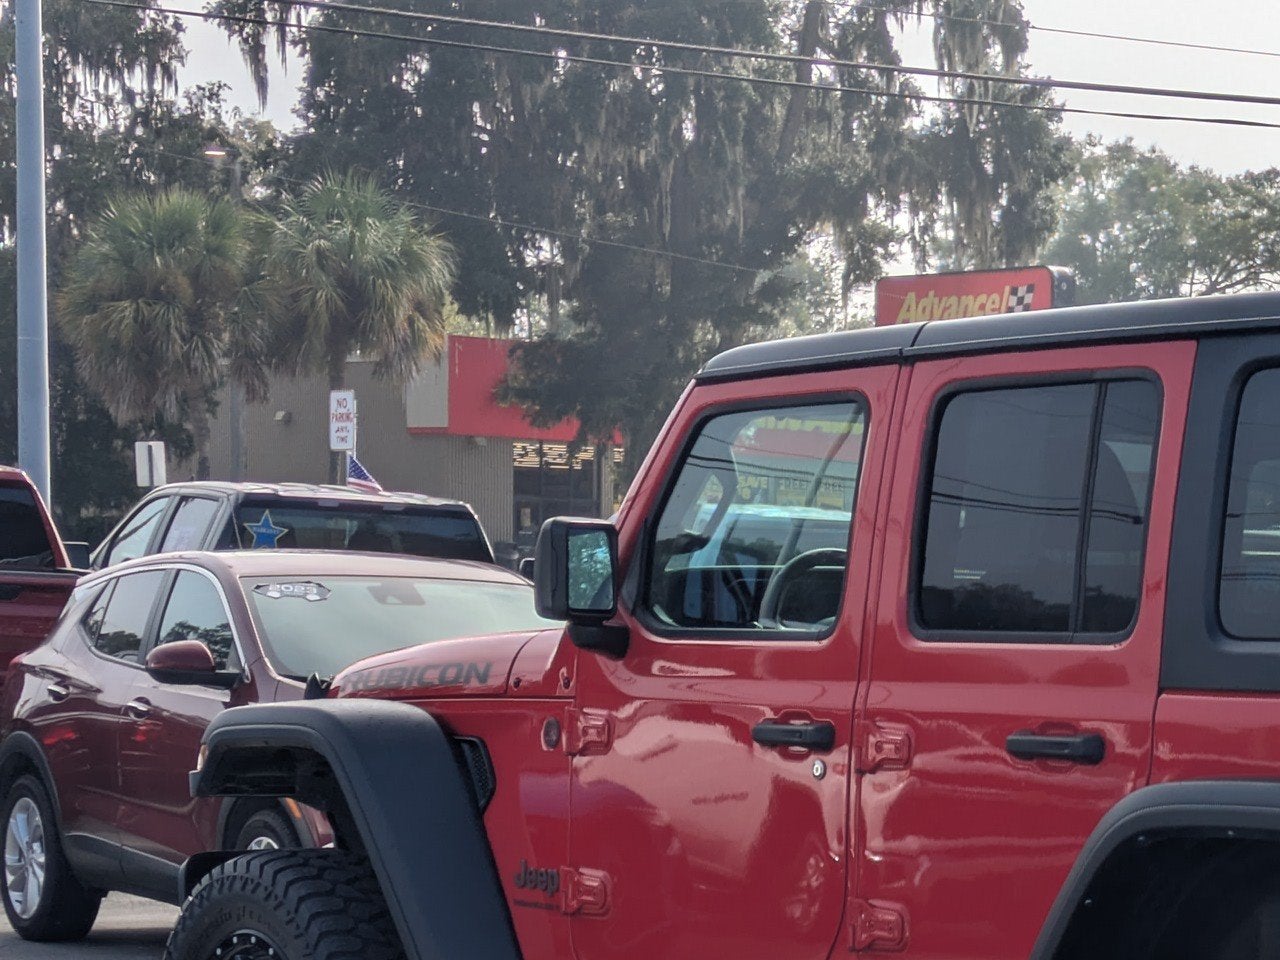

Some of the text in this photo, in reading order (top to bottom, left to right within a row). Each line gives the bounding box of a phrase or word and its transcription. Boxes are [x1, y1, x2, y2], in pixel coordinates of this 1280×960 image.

[895, 290, 1001, 324] Advance
[336, 398, 348, 408] NO
[339, 662, 492, 692] RUBICON
[514, 859, 559, 896] Jeep
